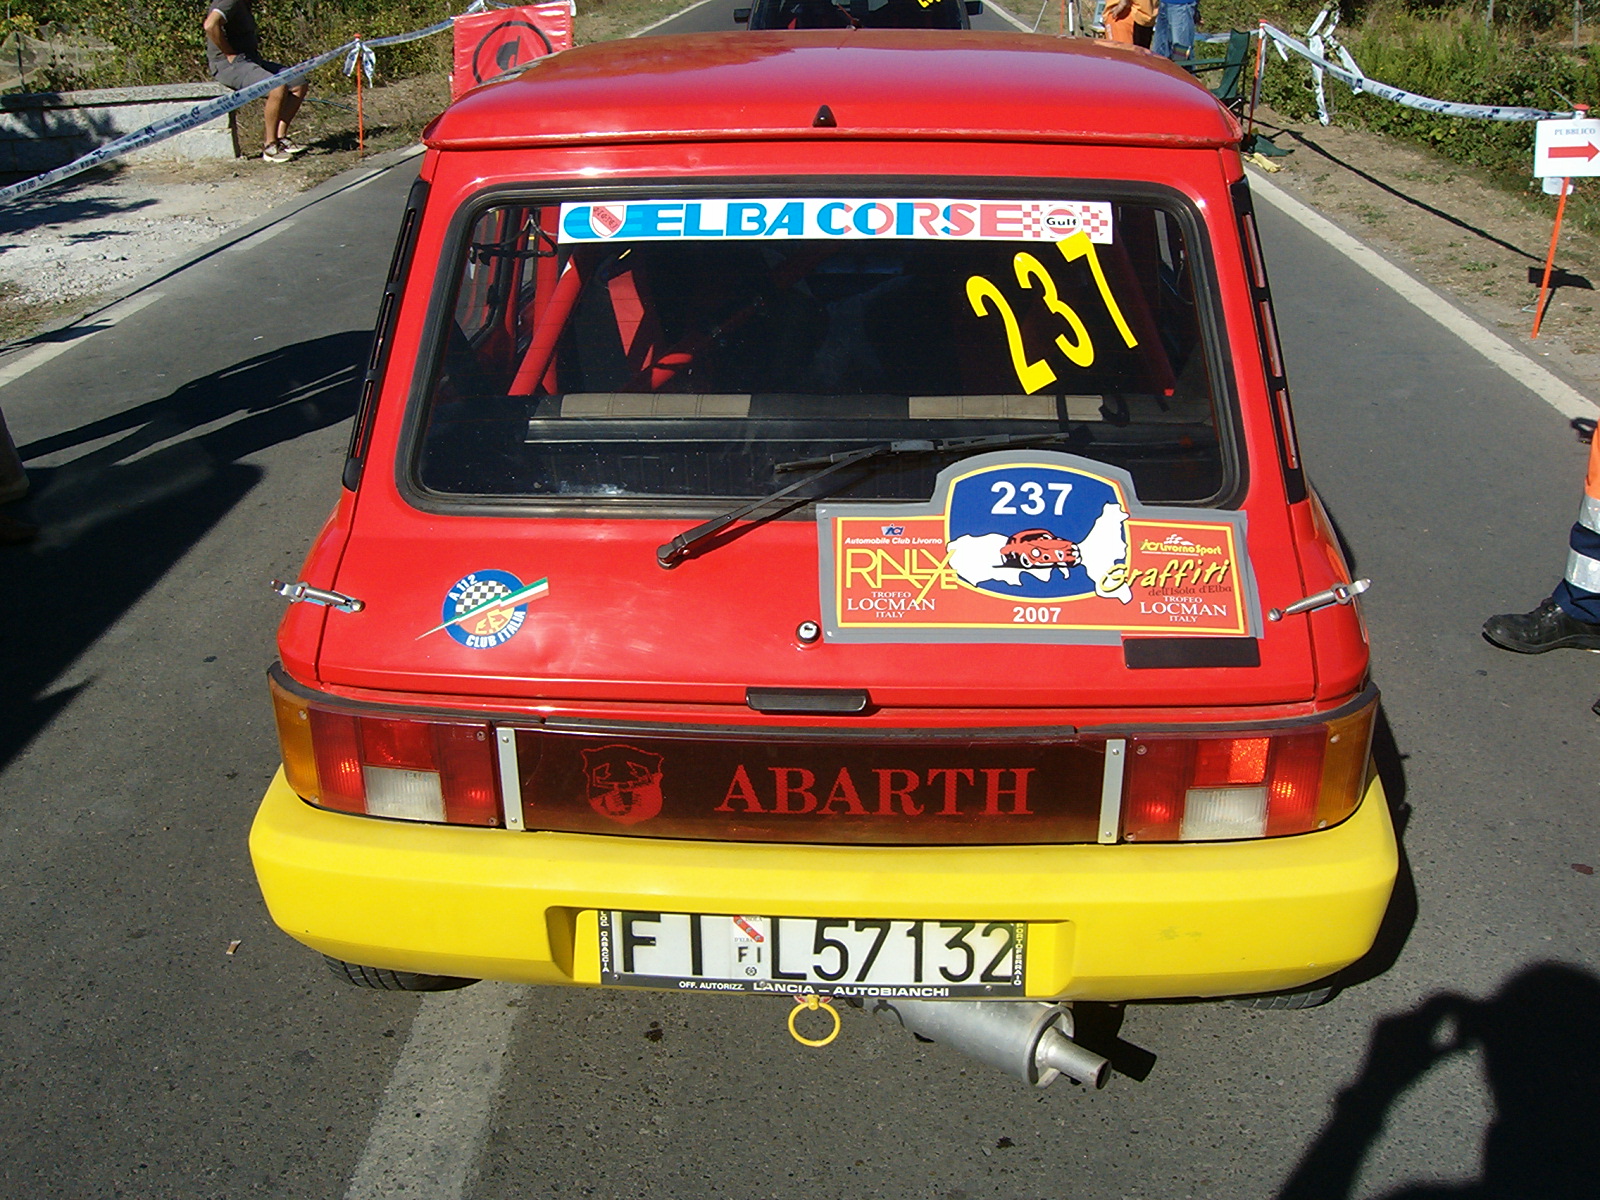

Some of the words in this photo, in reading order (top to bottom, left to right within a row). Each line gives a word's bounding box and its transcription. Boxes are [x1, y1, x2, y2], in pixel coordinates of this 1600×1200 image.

[649, 202, 805, 238] ELBA
[817, 202, 1024, 238] CORSE
[1046, 216, 1077, 226] Gulf
[965, 229, 1139, 396] 237
[990, 480, 1073, 516] 237
[845, 537, 890, 545] Automobile
[891, 537, 911, 545] Club
[912, 537, 943, 545] Livorno
[1099, 559, 1231, 593] Graffiti
[1148, 587, 1196, 597] dell'Isola
[1199, 585, 1232, 594] d'Elba
[1163, 595, 1203, 603] TROFEO
[847, 598, 936, 611] LOCMAN
[1139, 602, 1227, 616] LOCMAN
[1013, 606, 1062, 622] 2007
[465, 634, 497, 648] CLUB
[497, 611, 526, 643] ITALIA
[714, 764, 1036, 816] ABARTH
[679, 981, 698, 989] OFF.
[699, 982, 745, 991] AUTORIZZ.
[753, 983, 815, 994] LANCIA
[833, 986, 950, 997] AUTOBIANCHI
